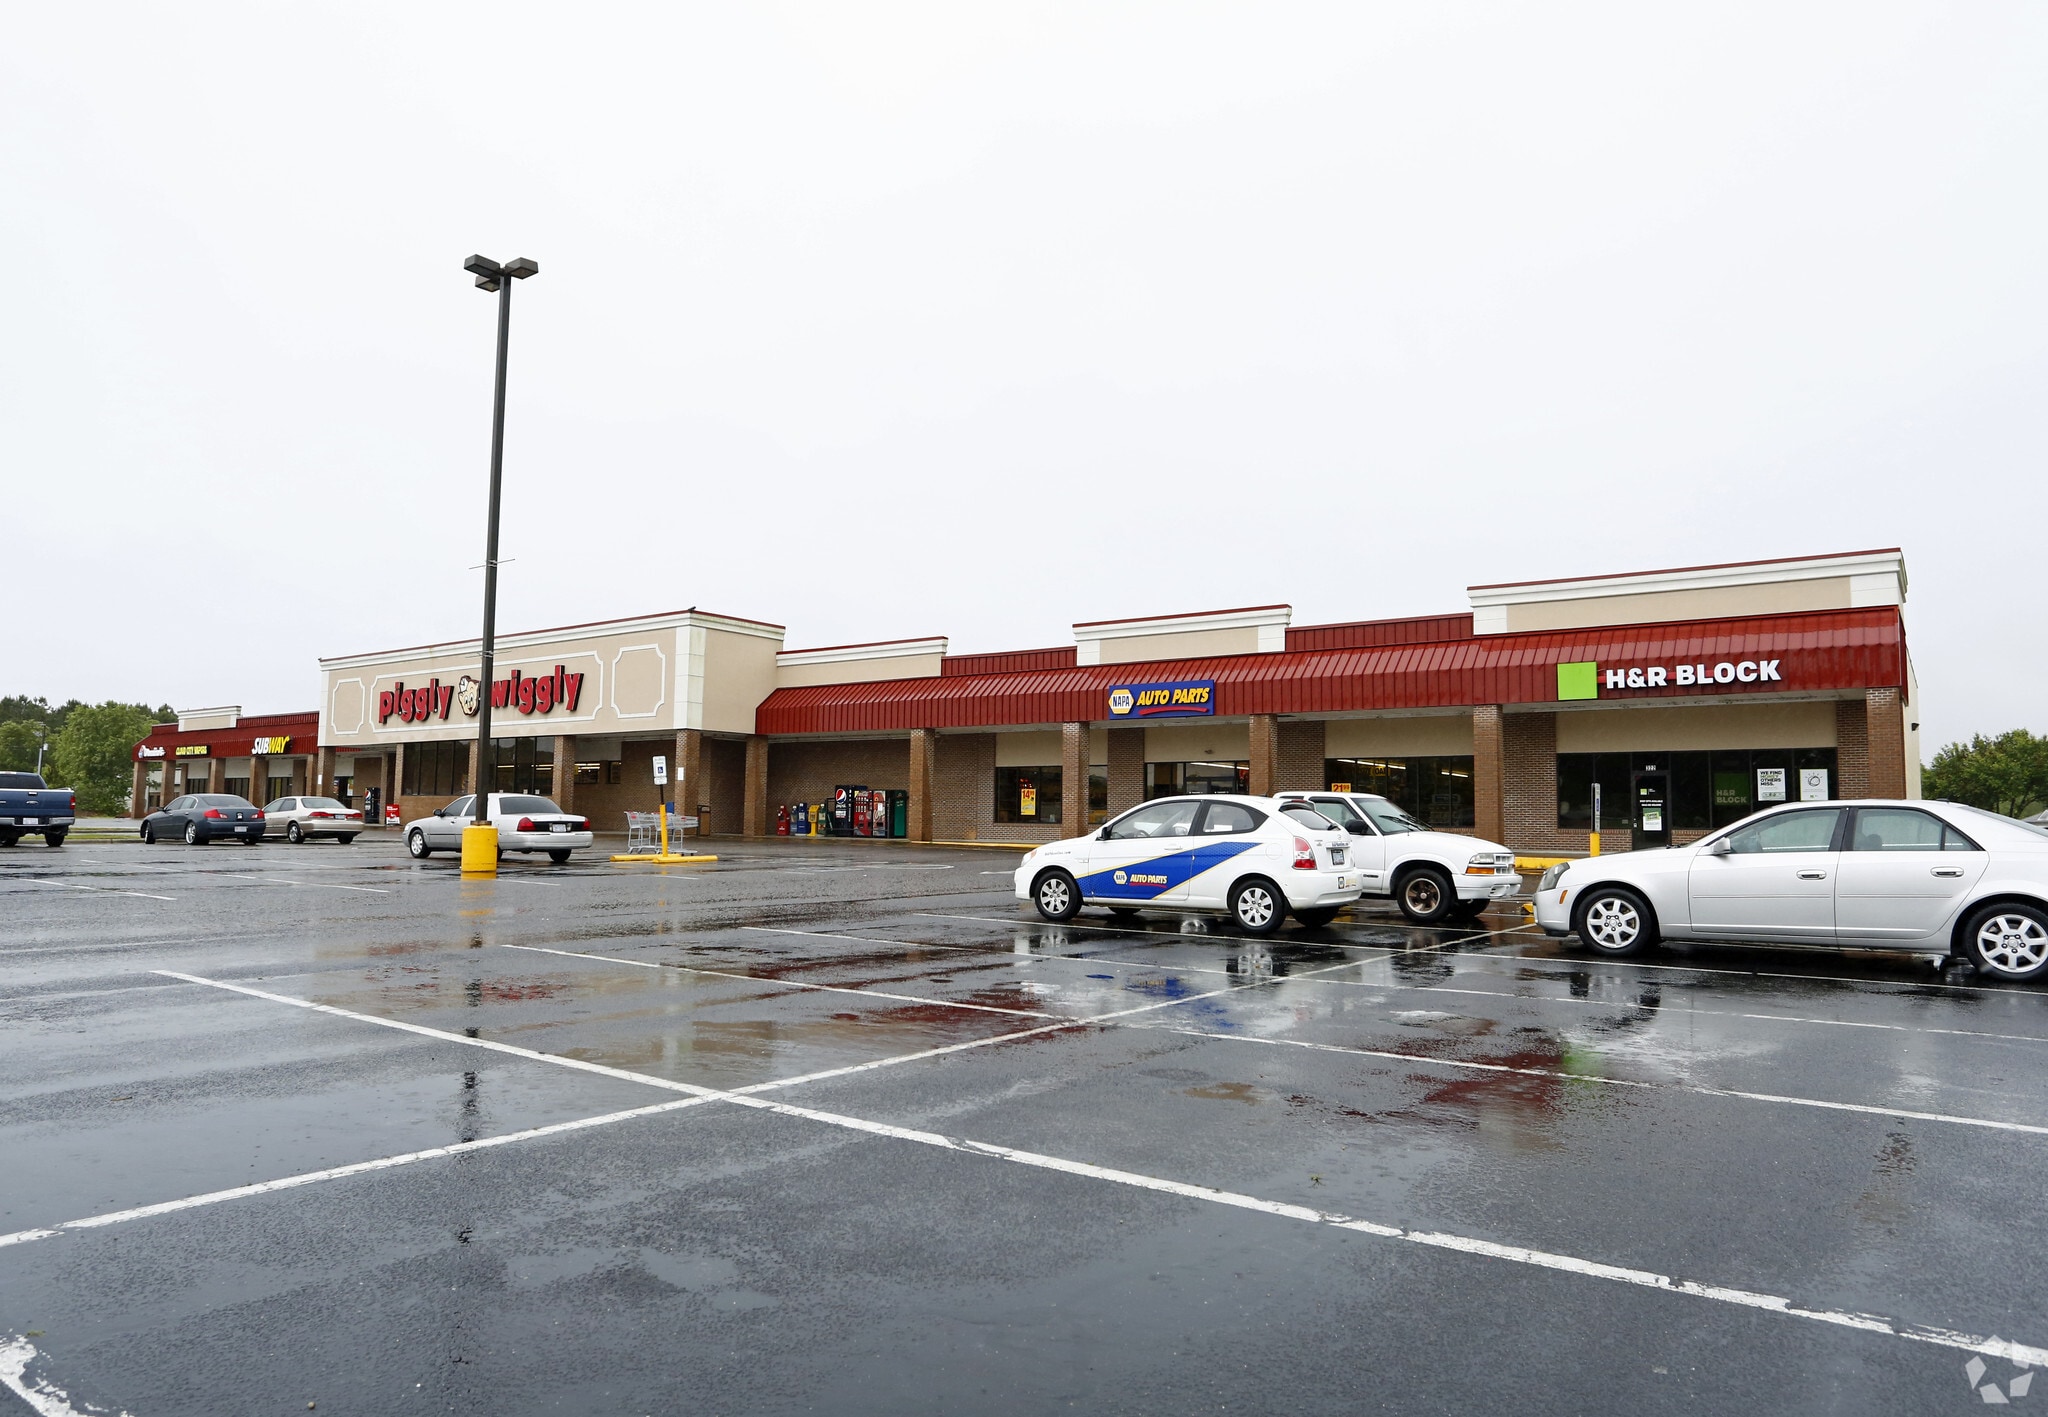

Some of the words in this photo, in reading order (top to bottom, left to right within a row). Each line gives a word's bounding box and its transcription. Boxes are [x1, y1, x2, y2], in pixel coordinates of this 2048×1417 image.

[1606, 667, 1668, 689] H&R
[1675, 659, 1782, 687] BLOCK
[379, 678, 454, 724] piggly
[491, 665, 584, 714] wiggly
[1112, 695, 1131, 708] NAPA
[1136, 689, 1171, 706] AUTO
[1171, 687, 1210, 705] PARTS
[251, 735, 290, 755] SUBWAY
[1716, 796, 1747, 804] BLOCK
[1130, 874, 1148, 883] AUTO
[1147, 875, 1168, 884] PARTS
